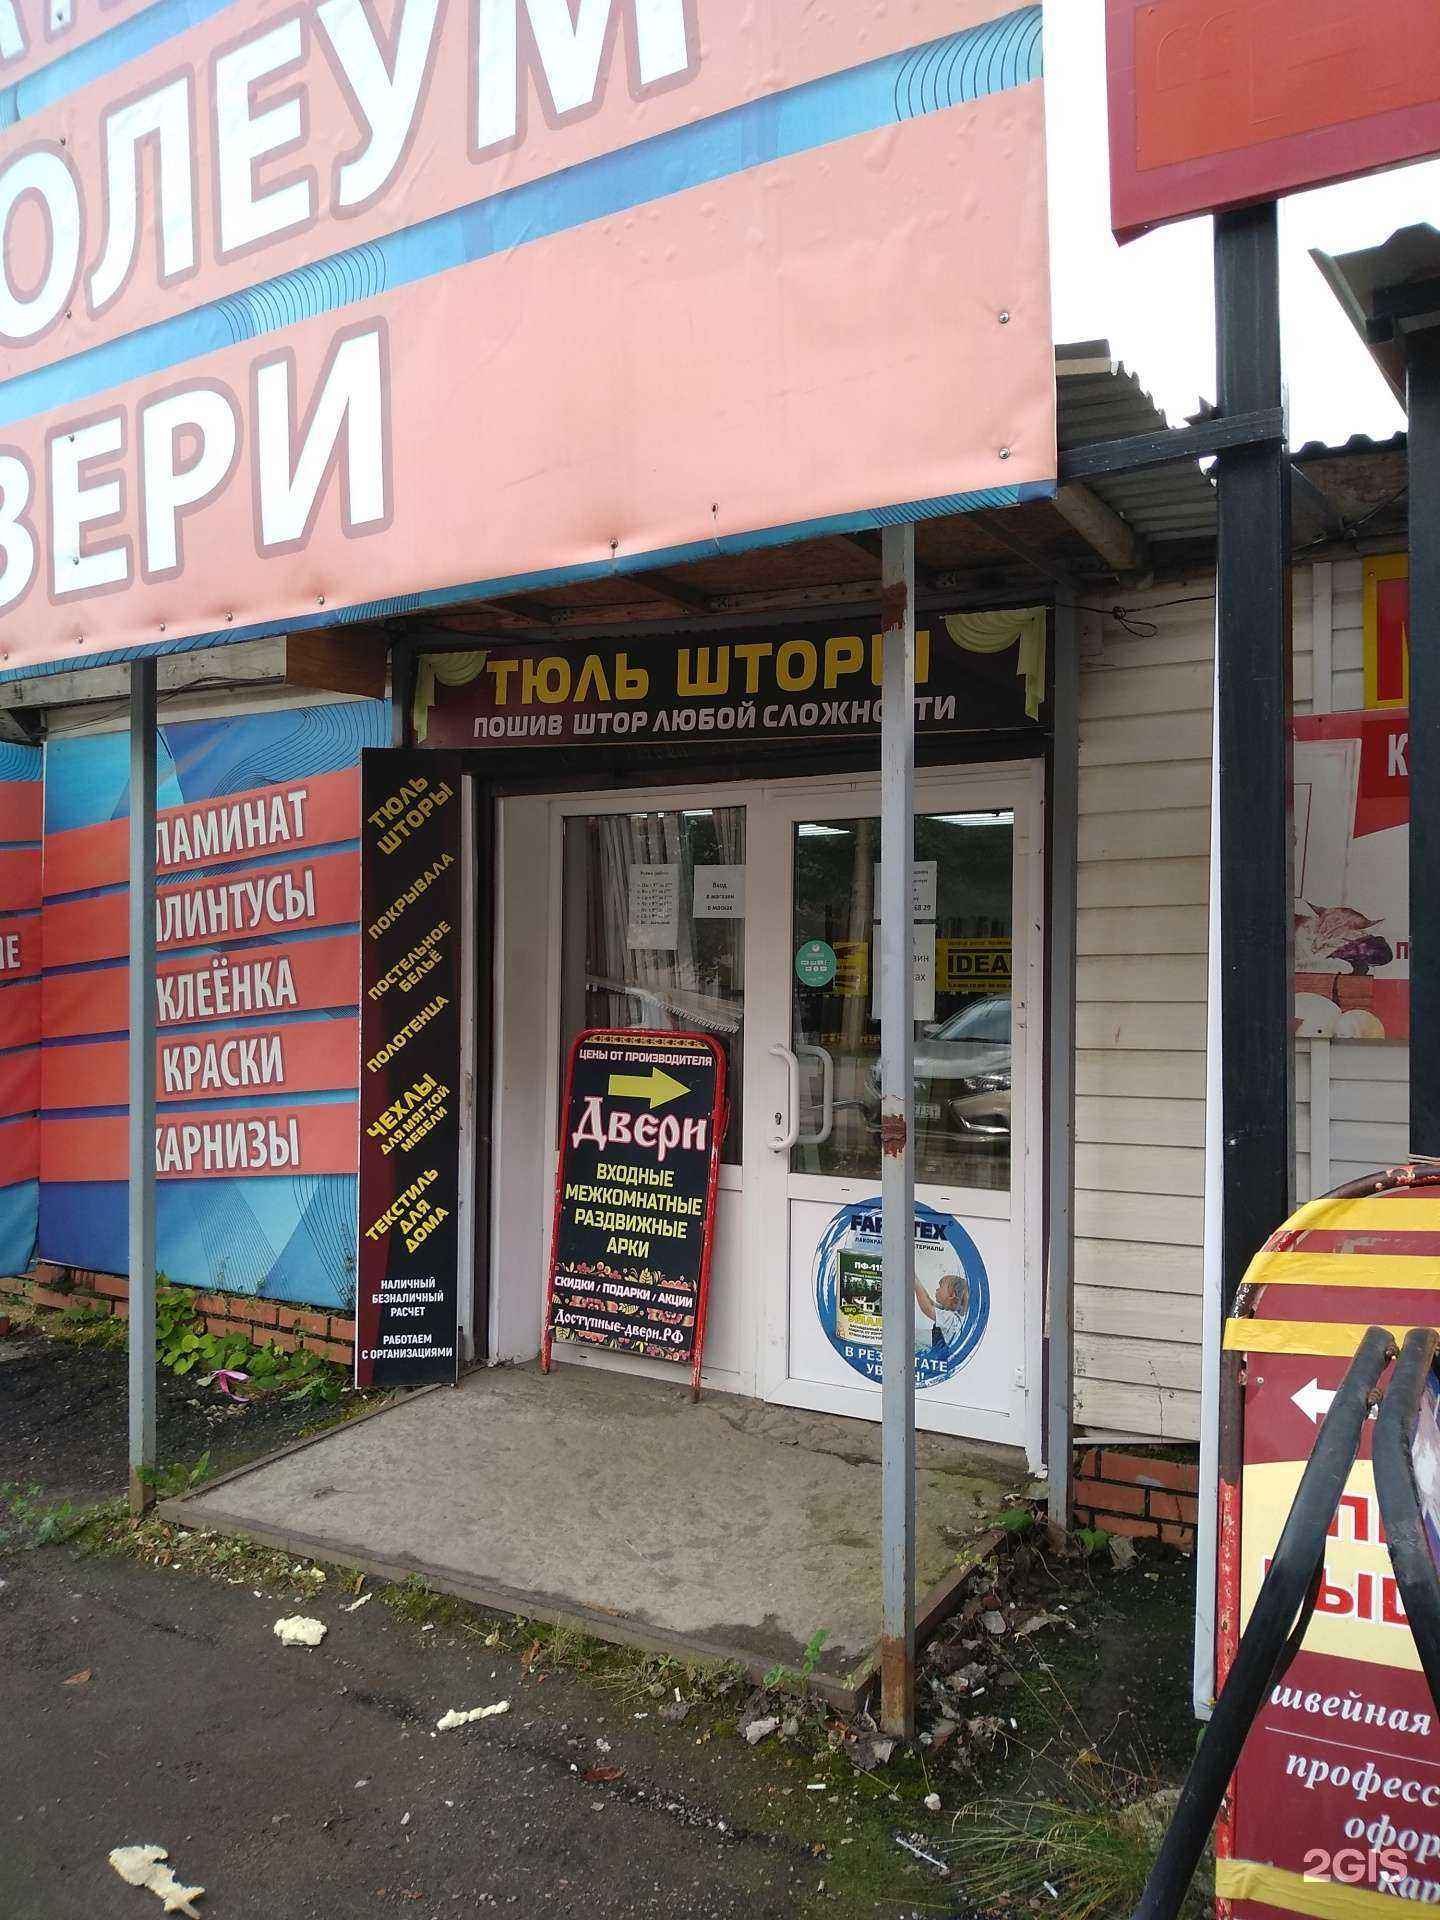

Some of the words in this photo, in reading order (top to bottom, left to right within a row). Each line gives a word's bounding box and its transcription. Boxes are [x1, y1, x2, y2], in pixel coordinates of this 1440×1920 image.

[486, 651, 649, 706] ТЮЛЬ
[473, 714, 563, 738] ПОШИВ
[573, 710, 649, 736] ШТОР
[652, 700, 756, 733] ЛЮБОЙ
[763, 695, 957, 727] СЛОЖНОТИ
[367, 775, 429, 829] ТЮЛЬ
[376, 781, 454, 855] ШТОРЫ
[156, 790, 307, 865] ЛАМИНАТ
[156, 869, 316, 942] ЛИНТУСЫ
[368, 852, 455, 940] ПОКРЫВАЛА
[367, 919, 452, 1001] ПОСТЕЛЬНОЕ
[398, 949, 443, 993] БЕЛЬЁ
[156, 957, 297, 1022] КЛЕЁНКА
[366, 995, 450, 1073] ПОЛОТЕНЦА
[579, 1049, 608, 1060] ЦЕНЫ
[610, 1051, 623, 1061] ОТ
[625, 1051, 712, 1067] ПРОИЗВОДИТЕЛЯ
[163, 1035, 284, 1092] КРАСКИ
[366, 1072, 438, 1137] ЧЕХЛЫ
[380, 1129, 406, 1156] ДЛЯ
[407, 1084, 450, 1132] МЯГКОЙ
[400, 1105, 449, 1152] МЕБЕЛИ
[572, 1096, 707, 1162] Двери
[596, 1163, 674, 1187] ВХОДНЫЕ
[365, 1168, 440, 1242] ТЕКСТИЛЬ
[399, 1199, 432, 1235] ДЛЯ
[565, 1183, 703, 1216] МЕЖКОМНАТНЫЕ
[574, 1208, 688, 1239] РАЗДВИЖНЫЕ
[405, 1206, 450, 1254] ДОМА
[606, 1236, 649, 1258] АРКИ
[372, 1290, 444, 1304] БЕЗНАЛИЧНЫЙ
[381, 1276, 436, 1289] НАЛИЧНЫЙ
[554, 1276, 595, 1291] СКИДКИ
[602, 1283, 650, 1301] ПОДАРКИ
[658, 1292, 693, 1308] АКЦИИ
[390, 1306, 425, 1317] РАСЧЕТ
[361, 1350, 369, 1360] С
[370, 1347, 453, 1359] ОРГАНИЗАЦИЯМИ
[383, 1334, 432, 1345] РАБОТАЕМ
[845, 1346, 854, 1357] В
[858, 1349, 948, 1373] РЕЗТАТЕ
[1270, 1684, 1431, 1736] швейная
[1286, 1752, 1440, 1807] професс
